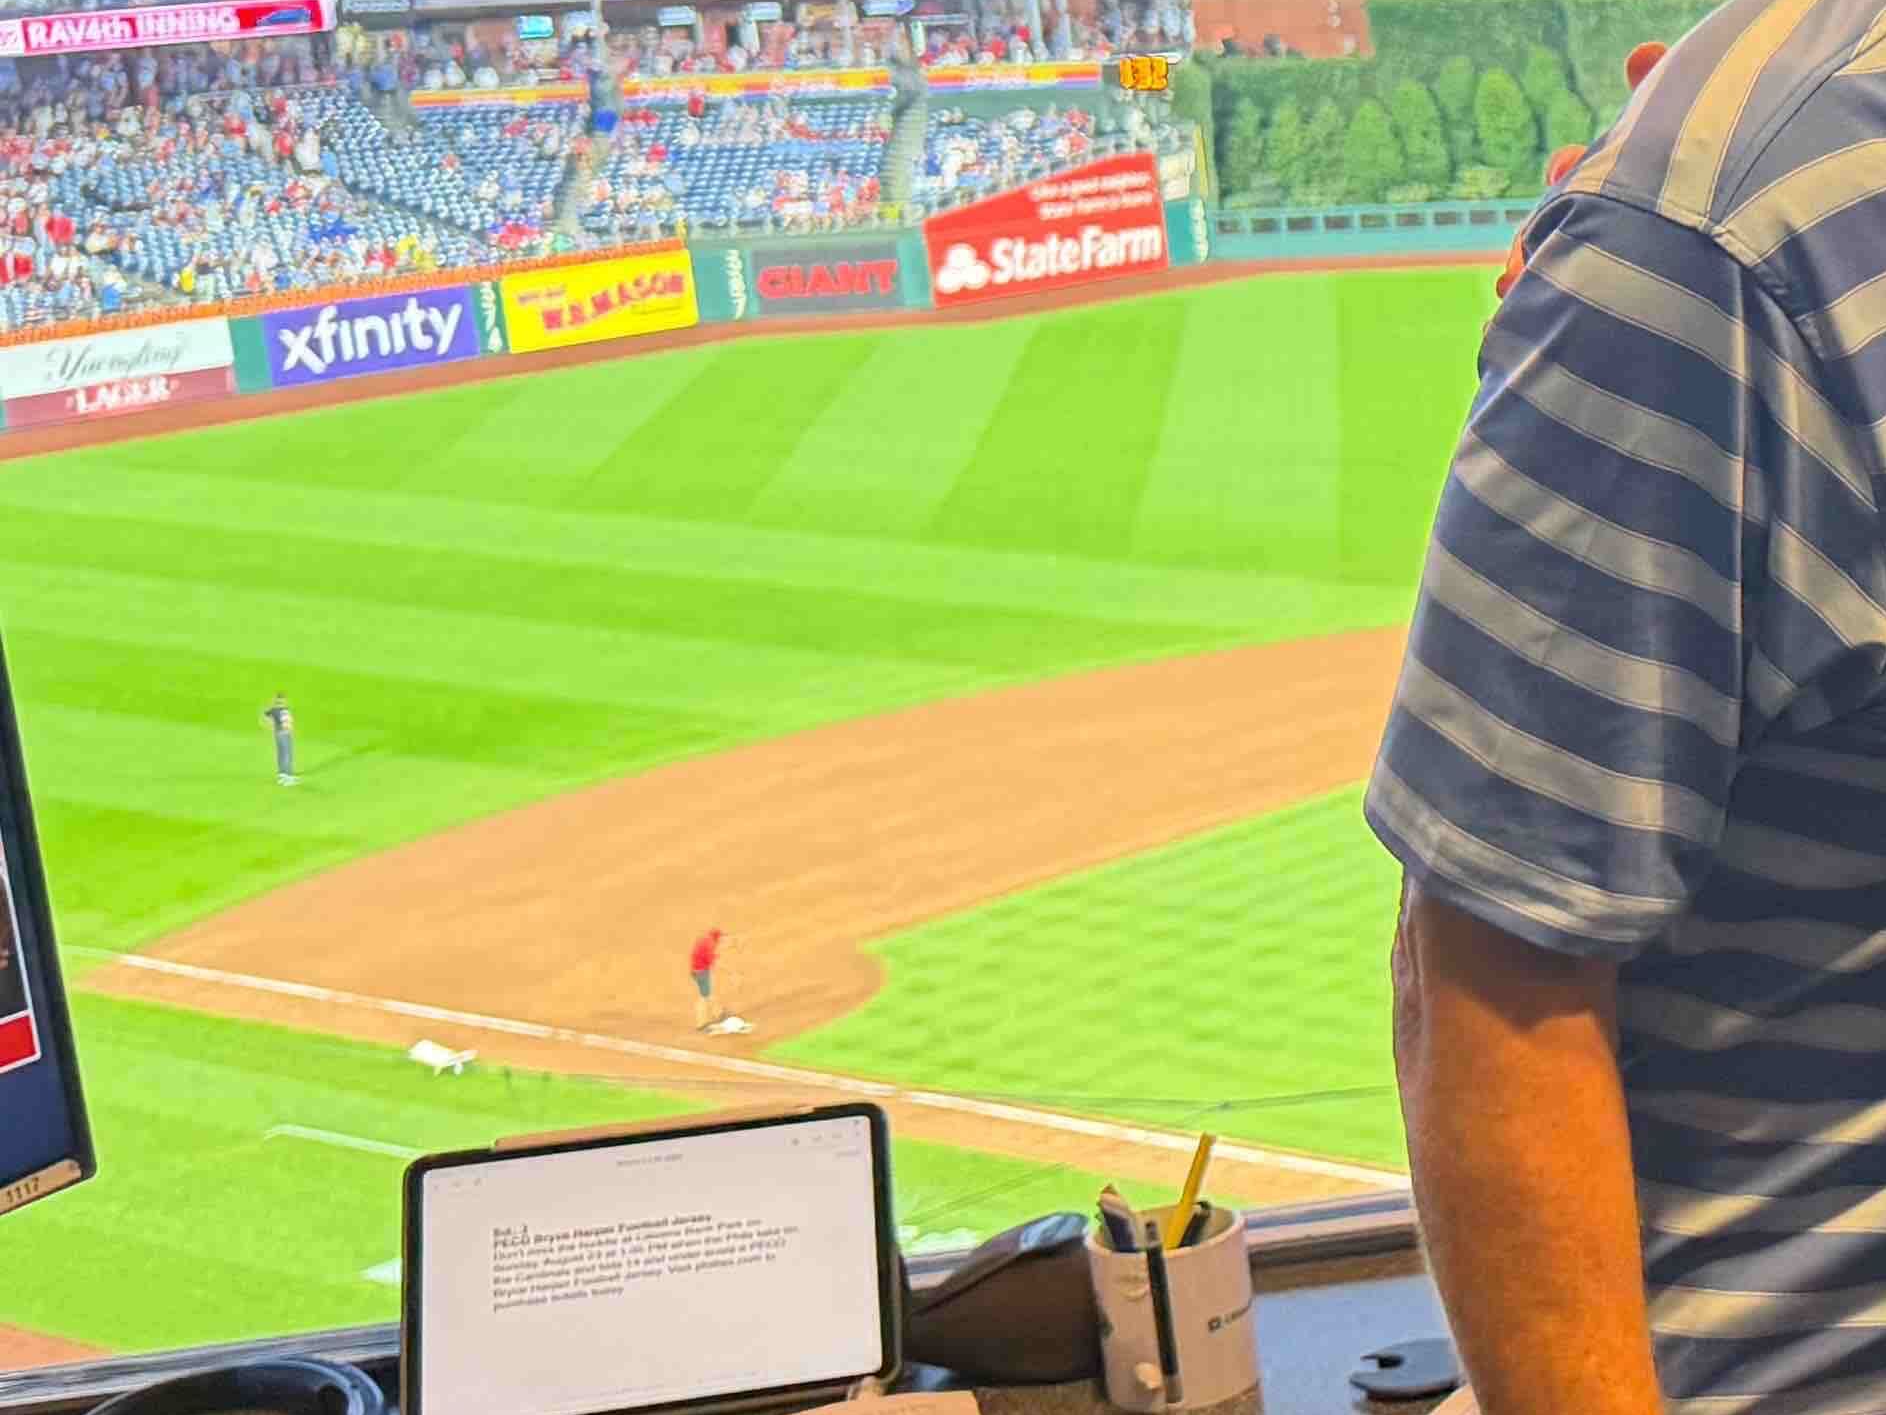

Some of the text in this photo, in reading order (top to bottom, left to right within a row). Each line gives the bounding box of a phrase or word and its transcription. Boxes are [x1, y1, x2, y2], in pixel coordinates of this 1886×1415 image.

[27, 6, 240, 51] RAV4th INNING
[756, 259, 898, 301] GIANT
[279, 297, 464, 375] xfinity
